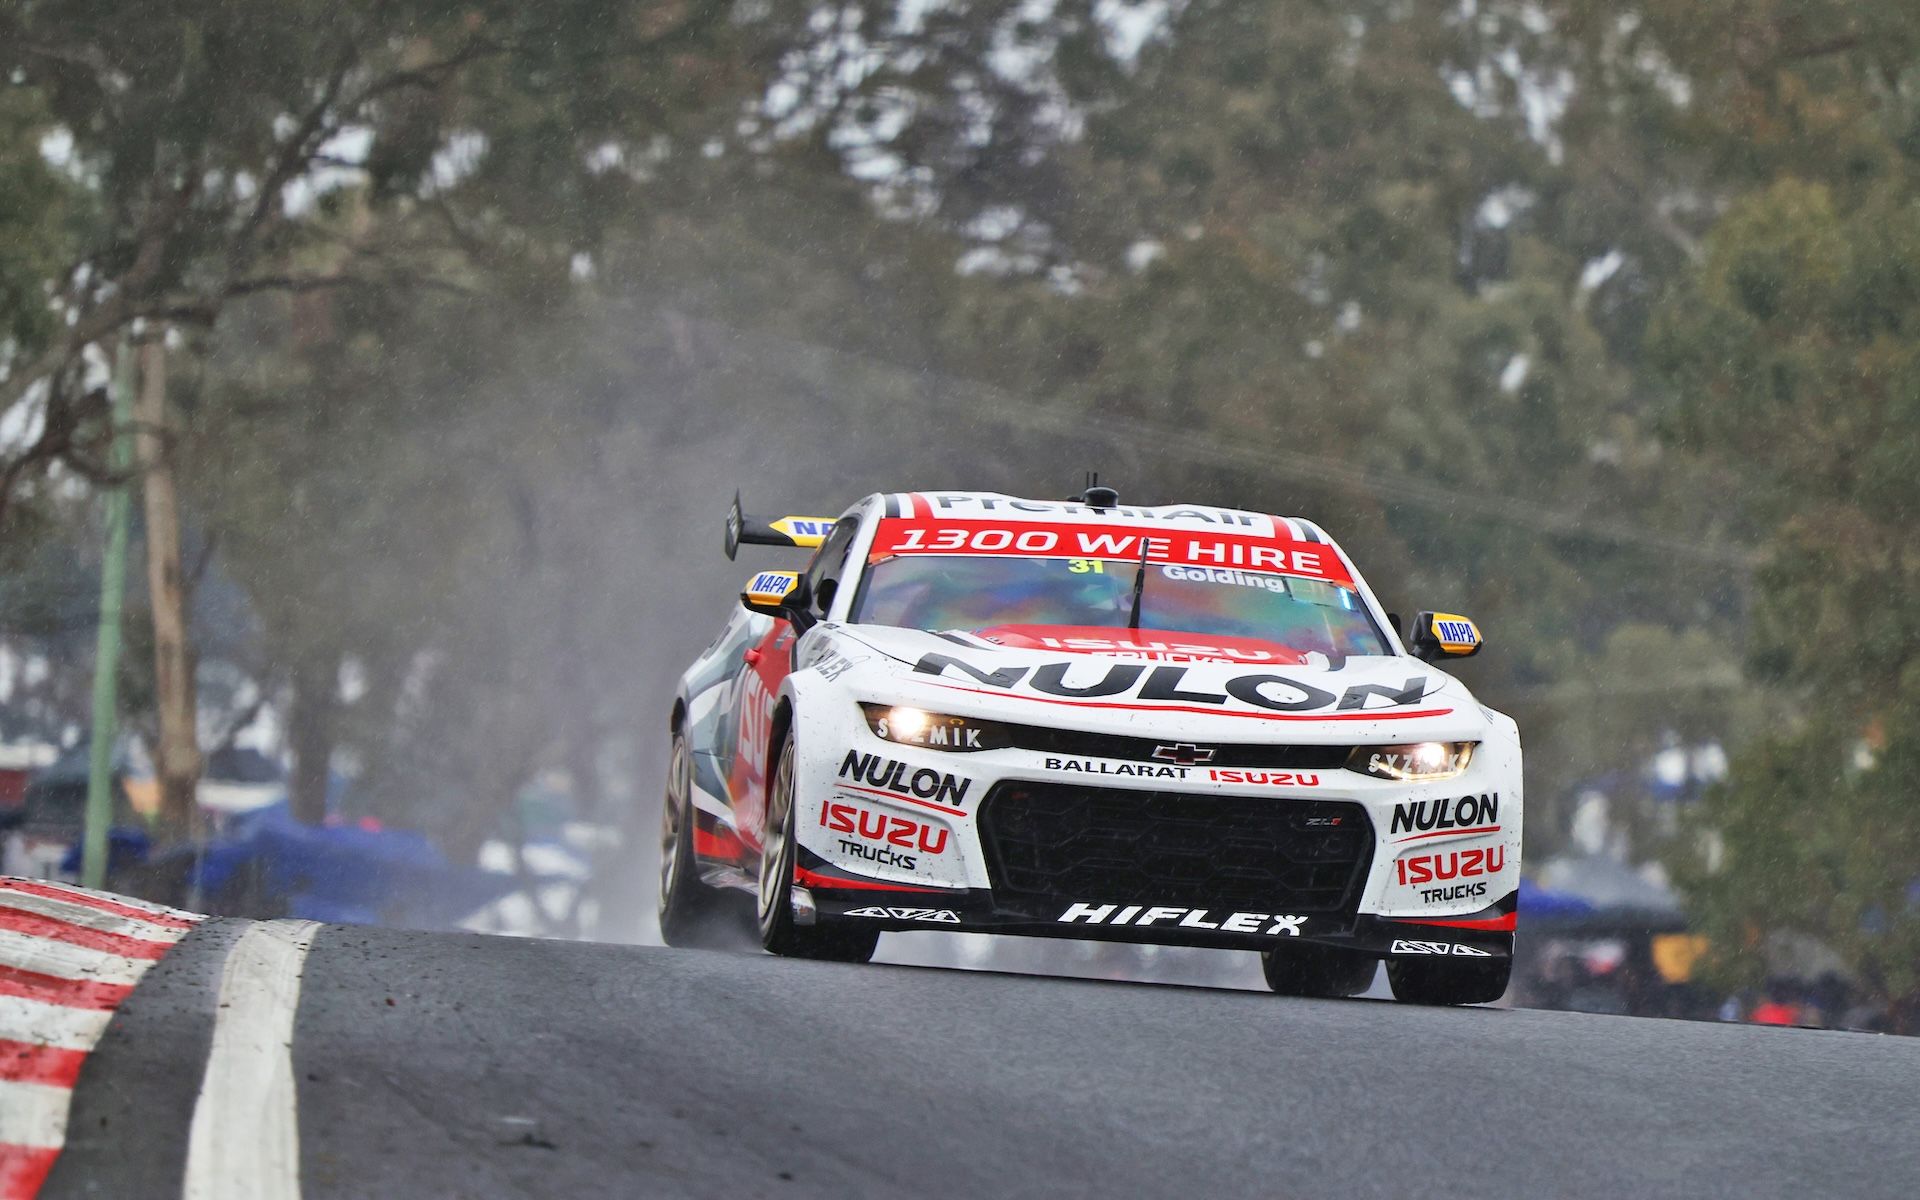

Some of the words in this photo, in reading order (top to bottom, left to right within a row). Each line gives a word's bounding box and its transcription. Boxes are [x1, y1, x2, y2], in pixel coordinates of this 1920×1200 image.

[891, 529, 1058, 551] 1300
[1077, 533, 1171, 559] WE
[1187, 540, 1324, 574] HIRE
[1067, 559, 1104, 574] 31
[751, 574, 792, 594] NAPA
[1162, 565, 1285, 593] Golding
[1438, 622, 1476, 643] NAPA
[1040, 638, 1273, 660] ISUZU
[912, 652, 1427, 711] NULON
[877, 717, 983, 749] SMIK
[838, 749, 973, 807] NULON
[1044, 758, 1191, 779] BALLARAT
[1209, 769, 1319, 786] ISUZU
[1367, 752, 1461, 774] SYZK
[819, 800, 949, 855] ISUZU
[1390, 792, 1498, 835] NULON
[838, 839, 917, 871] TRUCKS
[1397, 845, 1504, 886] ISUZU
[1420, 882, 1487, 904] TRUCKS
[1057, 902, 1309, 937] HIFLEX
